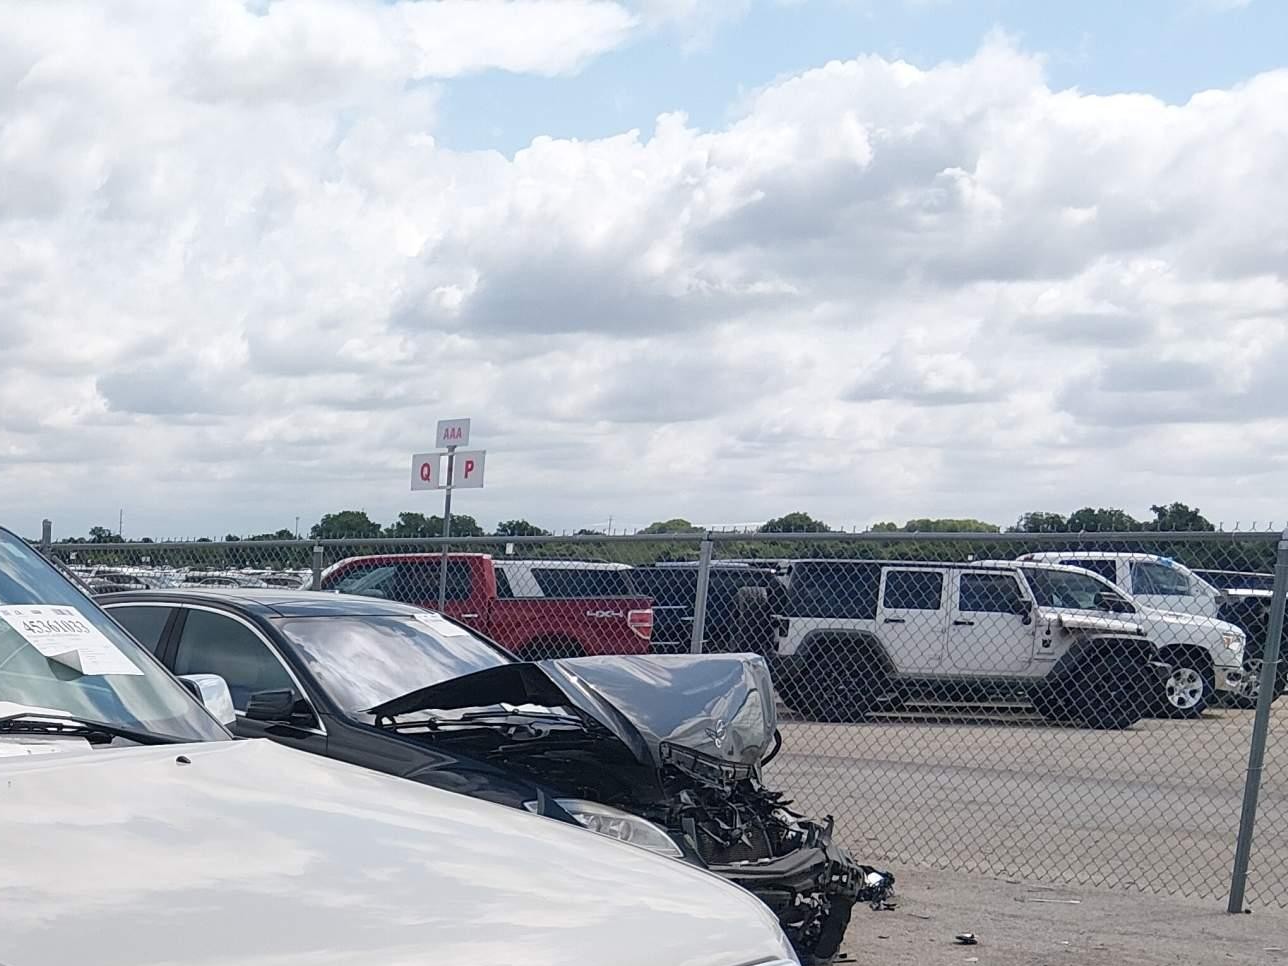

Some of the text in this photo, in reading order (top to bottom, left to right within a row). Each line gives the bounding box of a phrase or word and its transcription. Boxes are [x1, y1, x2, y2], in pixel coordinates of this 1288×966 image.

[443, 427, 462, 440] AAA
[420, 463, 431, 482] Q
[464, 460, 474, 479] P
[23, 620, 91, 634] 45361033
